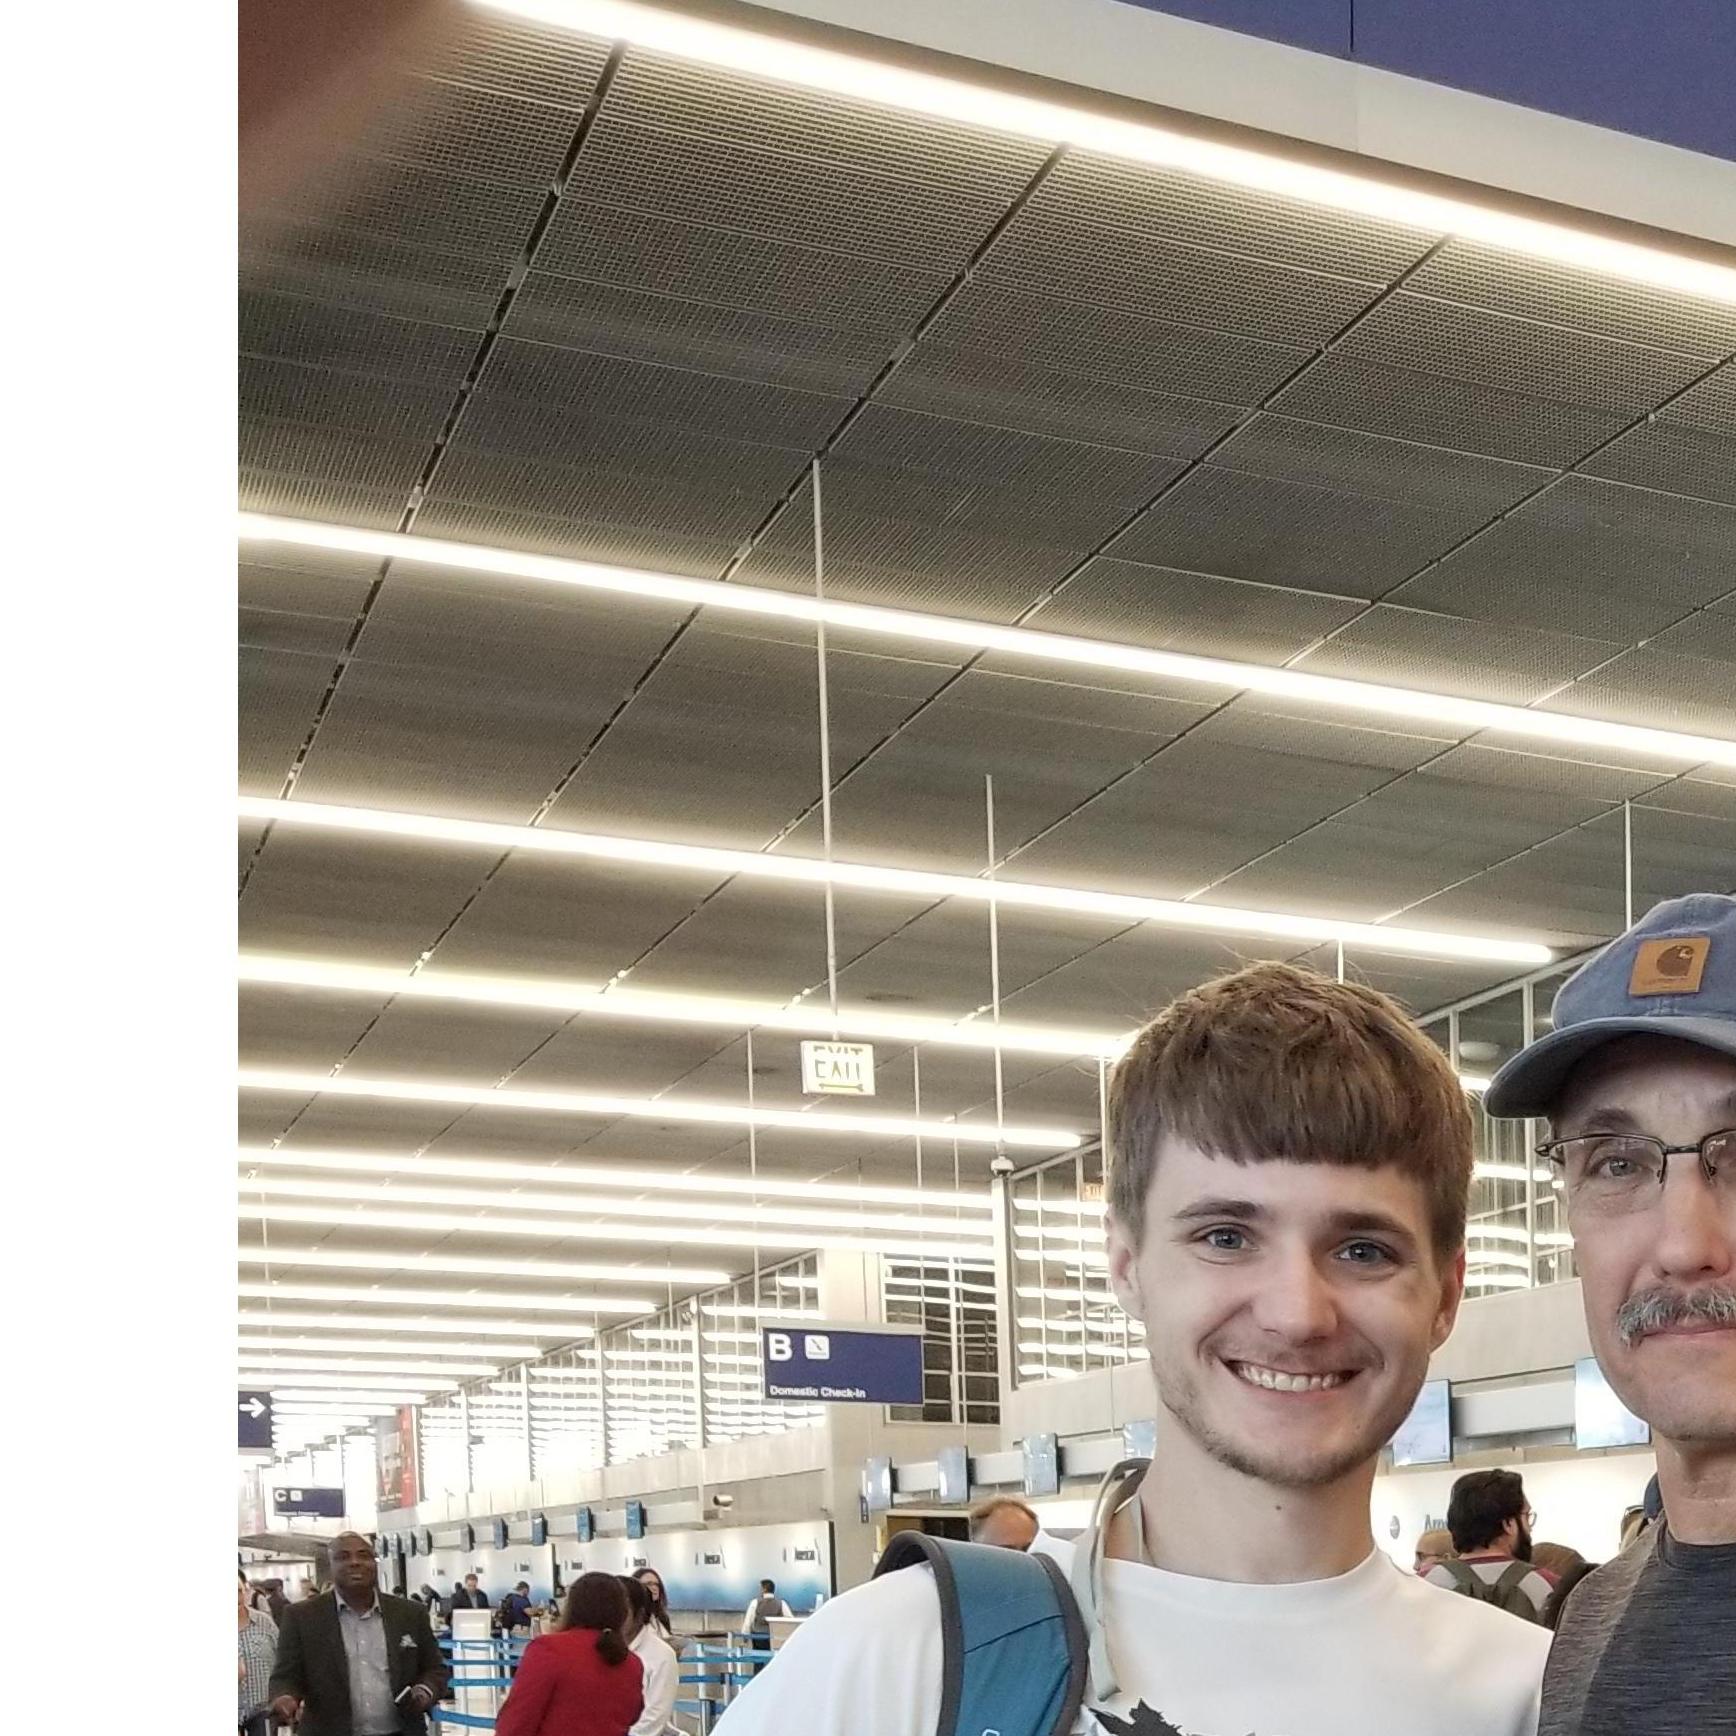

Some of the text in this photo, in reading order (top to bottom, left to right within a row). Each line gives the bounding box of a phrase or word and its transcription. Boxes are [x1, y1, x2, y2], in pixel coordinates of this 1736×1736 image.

[768, 1333, 793, 1361] B
[770, 1385, 818, 1397] Domestic
[274, 1489, 288, 1502] C
